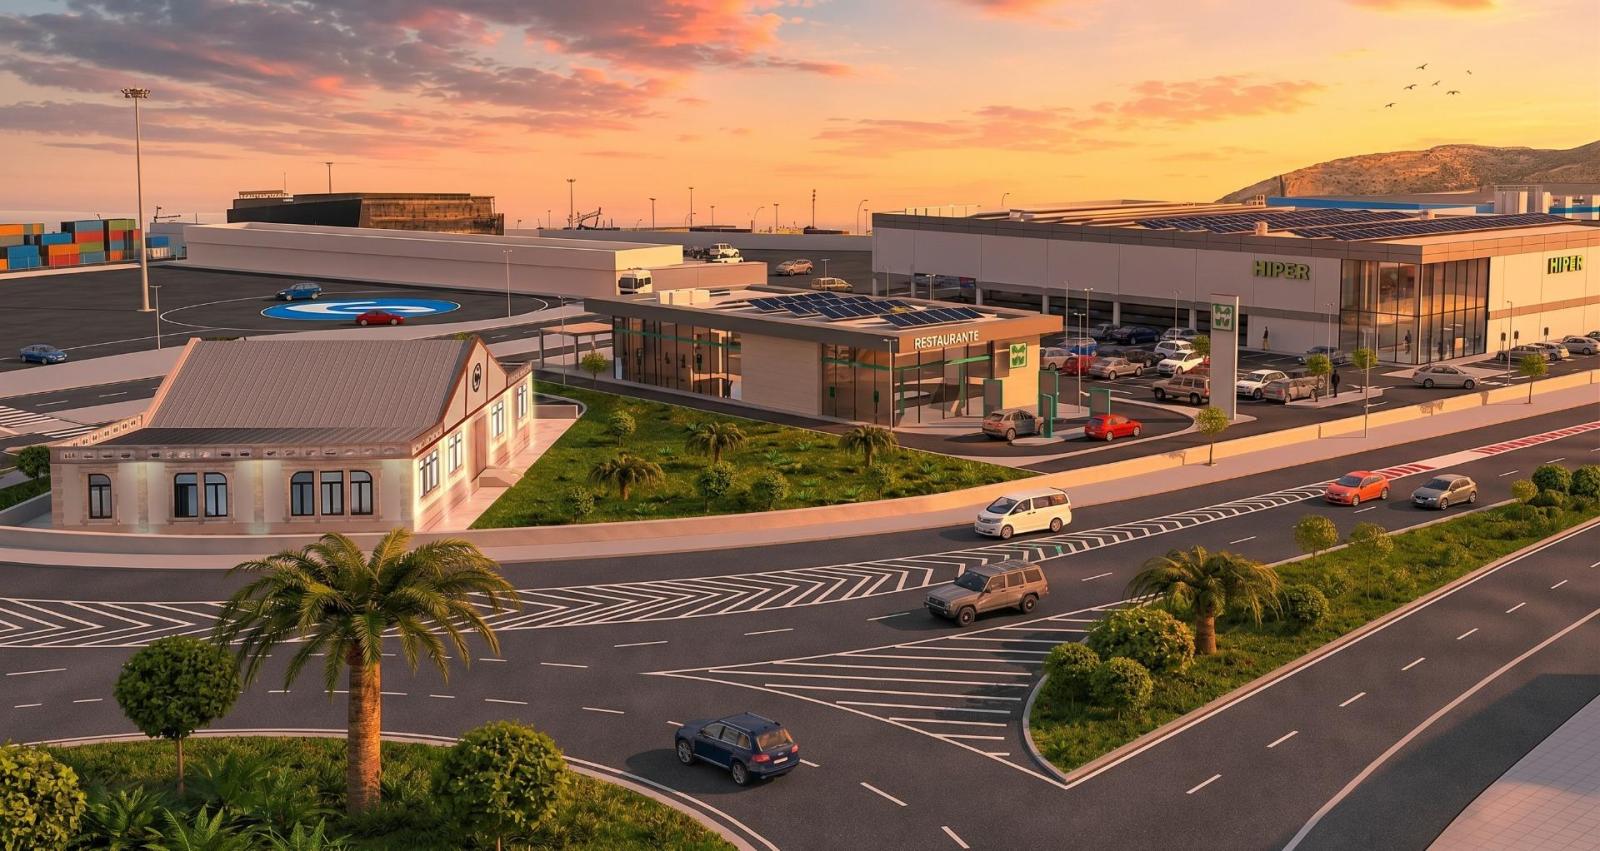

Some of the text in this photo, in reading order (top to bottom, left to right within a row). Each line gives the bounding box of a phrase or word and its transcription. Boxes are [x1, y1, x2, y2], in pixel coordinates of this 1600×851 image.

[1253, 260, 1310, 281] HIPER
[1547, 255, 1583, 274] HIPER
[914, 330, 979, 350] RESTAURANTE
